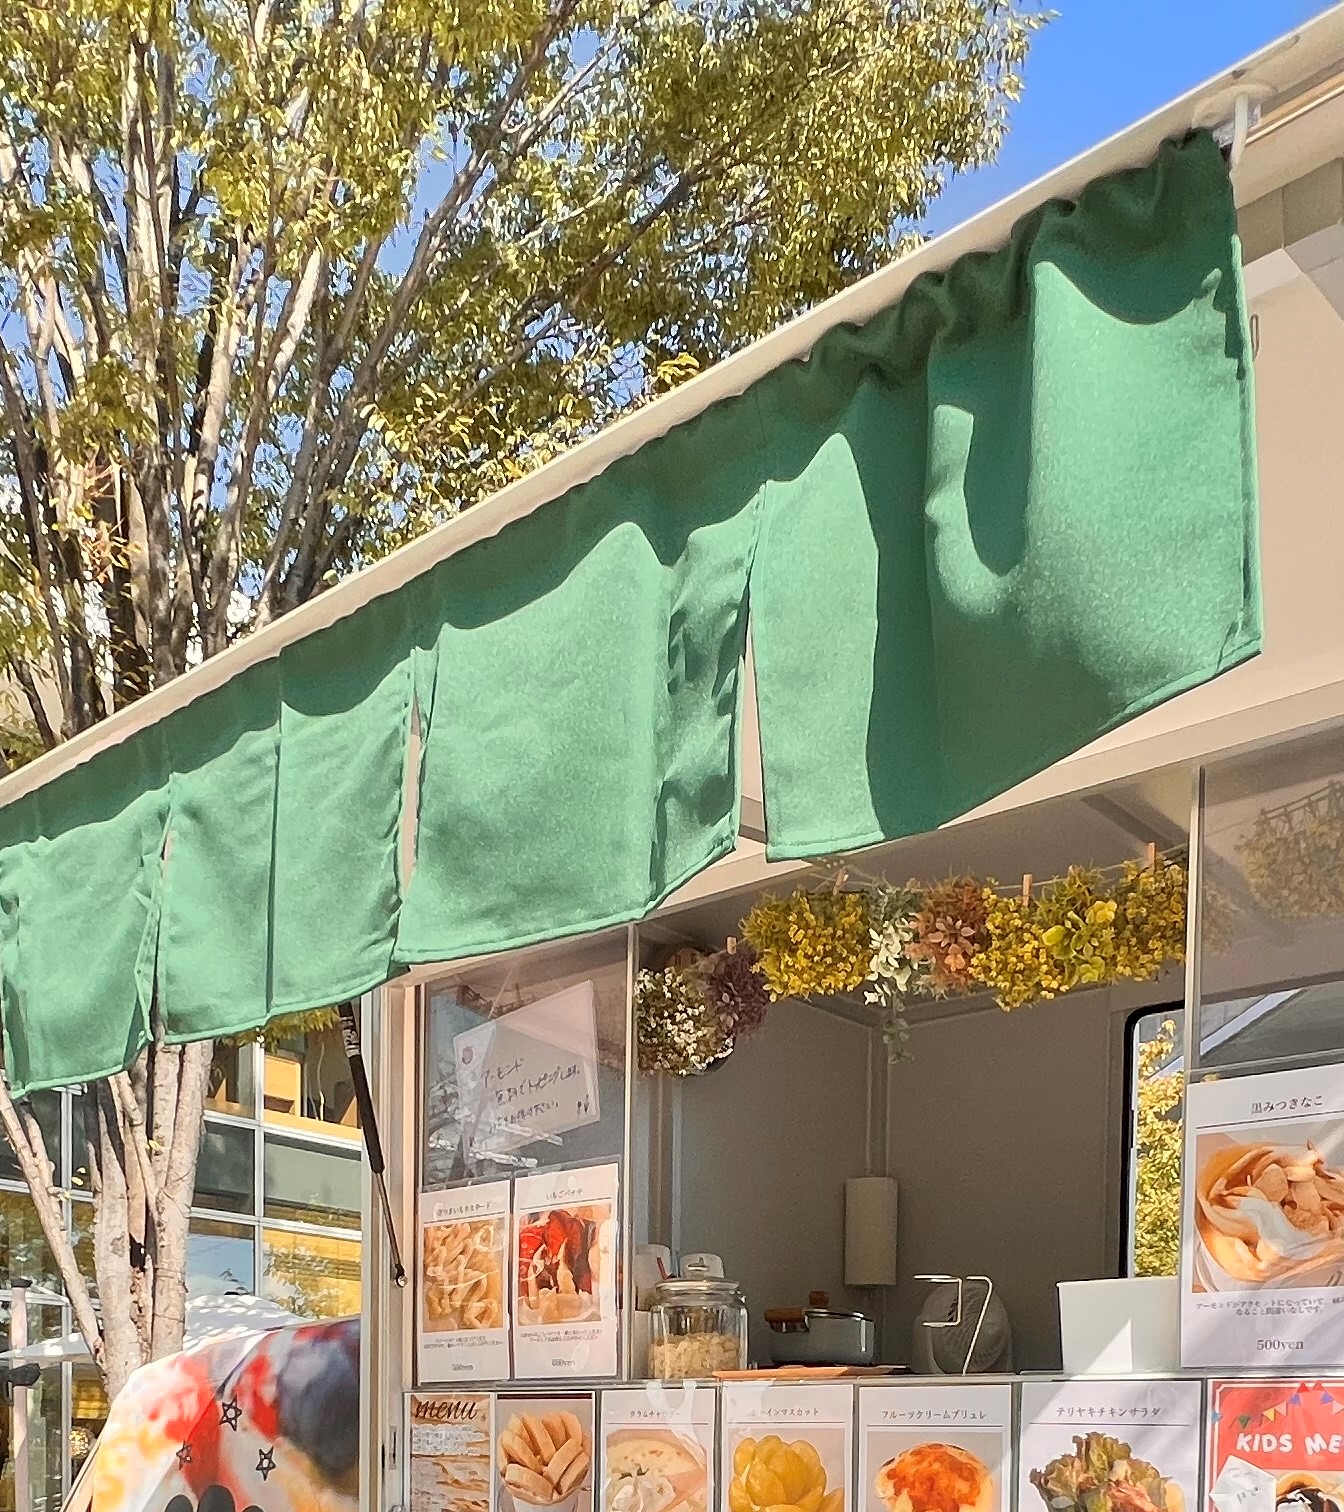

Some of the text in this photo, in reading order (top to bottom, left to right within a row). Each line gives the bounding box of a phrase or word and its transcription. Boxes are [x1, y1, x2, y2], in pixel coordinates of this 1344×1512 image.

[1257, 1339, 1304, 1351] 500yen
[414, 1399, 479, 1420] menu
[881, 1409, 987, 1420] フルーツクリームブリュレ
[1056, 1406, 1162, 1418] テリヤキチキンサラダ
[1236, 1432, 1294, 1453] KIDS
